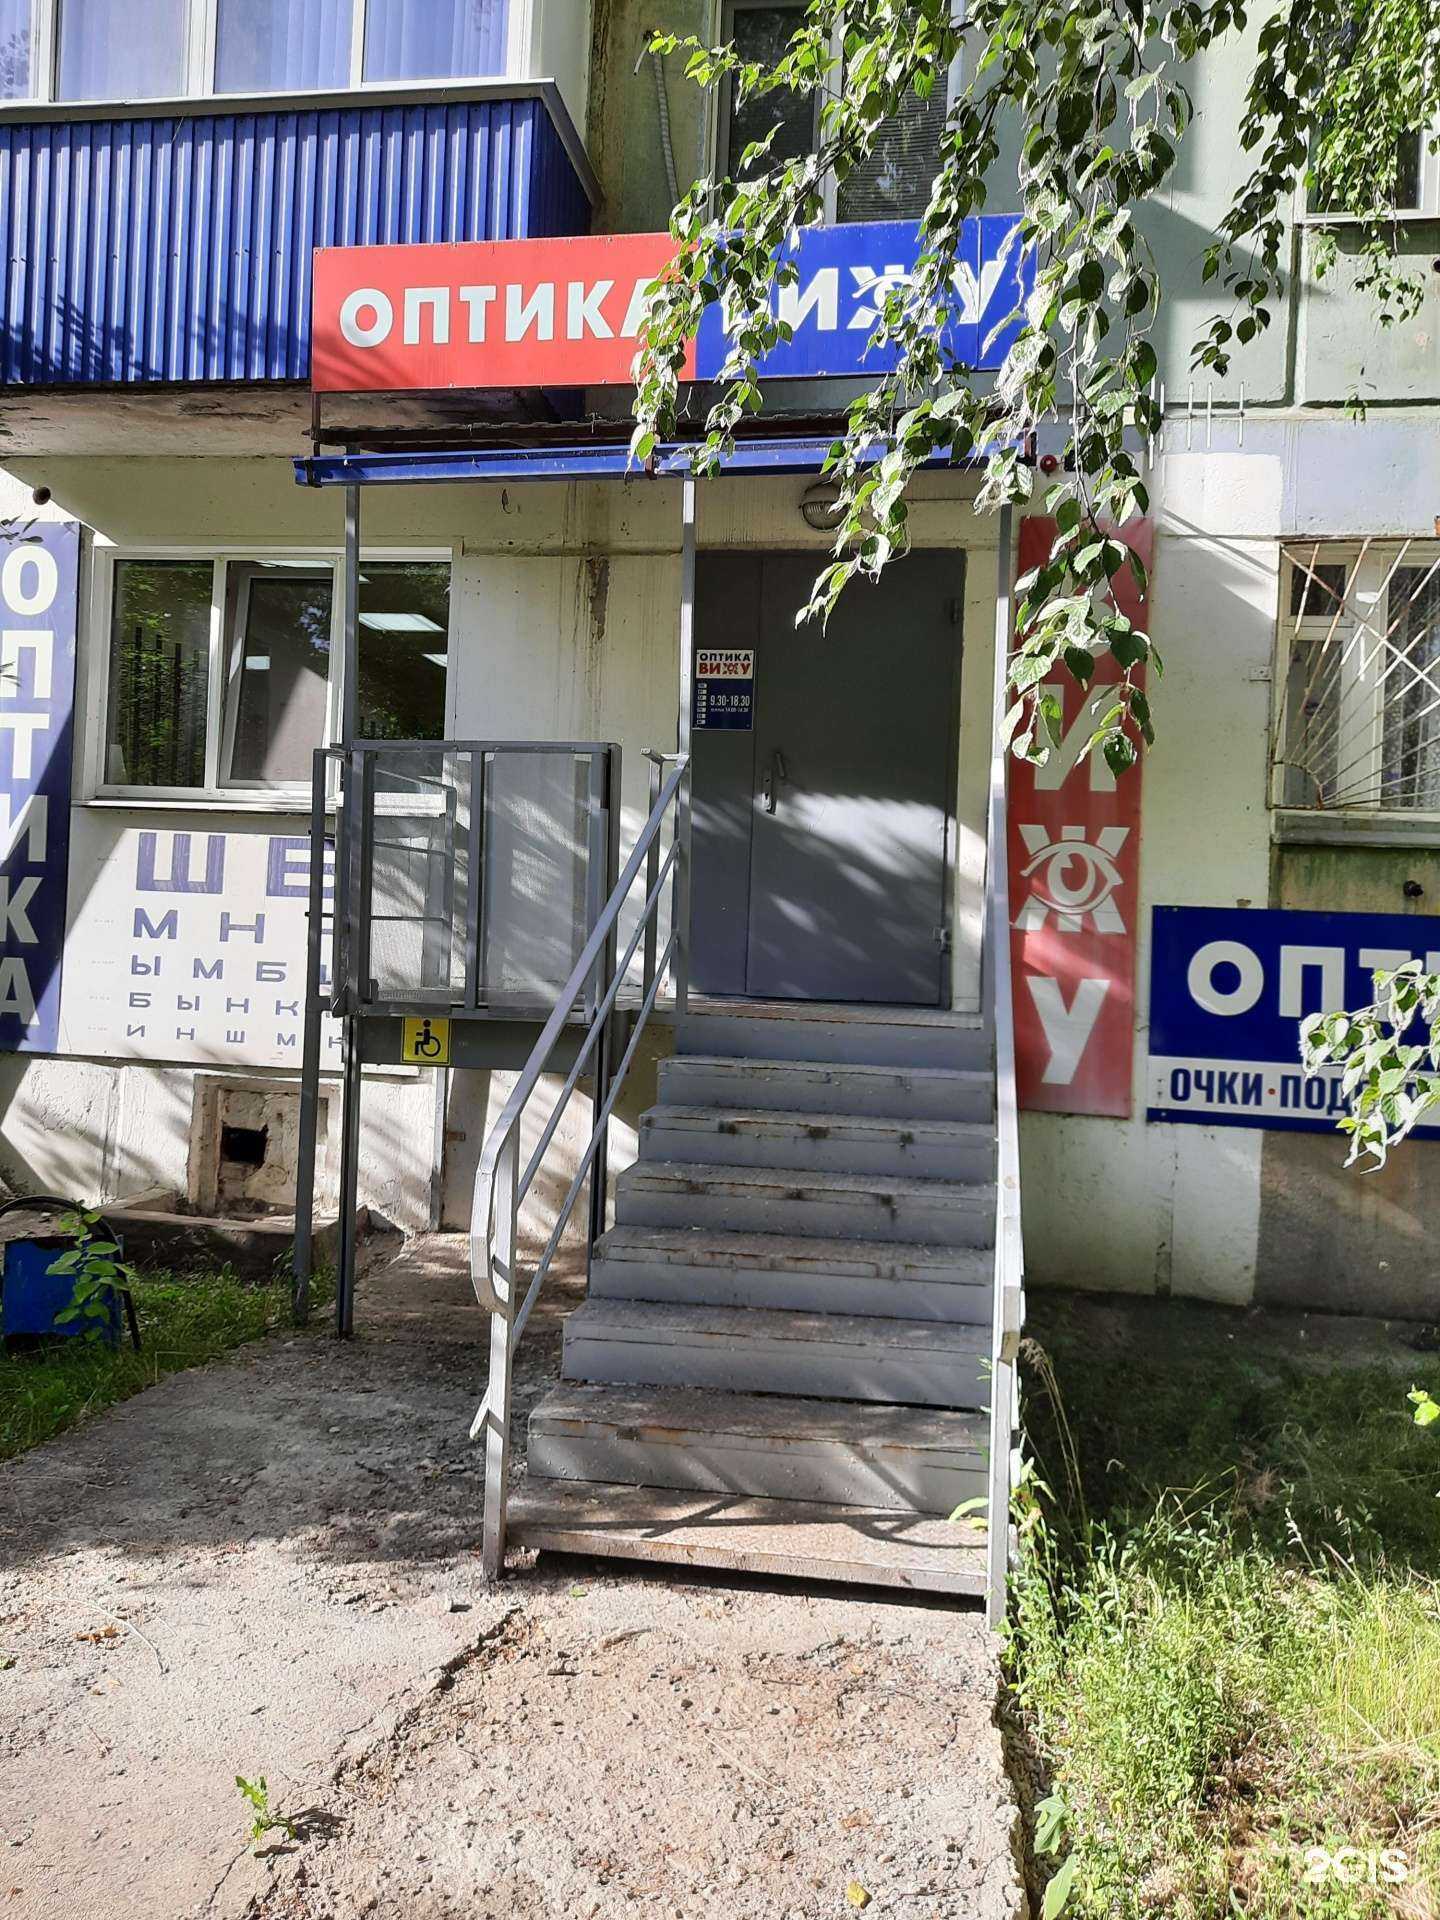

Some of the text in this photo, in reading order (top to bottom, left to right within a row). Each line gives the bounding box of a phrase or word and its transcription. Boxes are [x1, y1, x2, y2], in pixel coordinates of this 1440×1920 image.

[699, 652, 751, 662] ОПТИКА
[699, 662, 751, 675] ВИЖУ
[1187, 940, 1440, 1025] ОПТ
